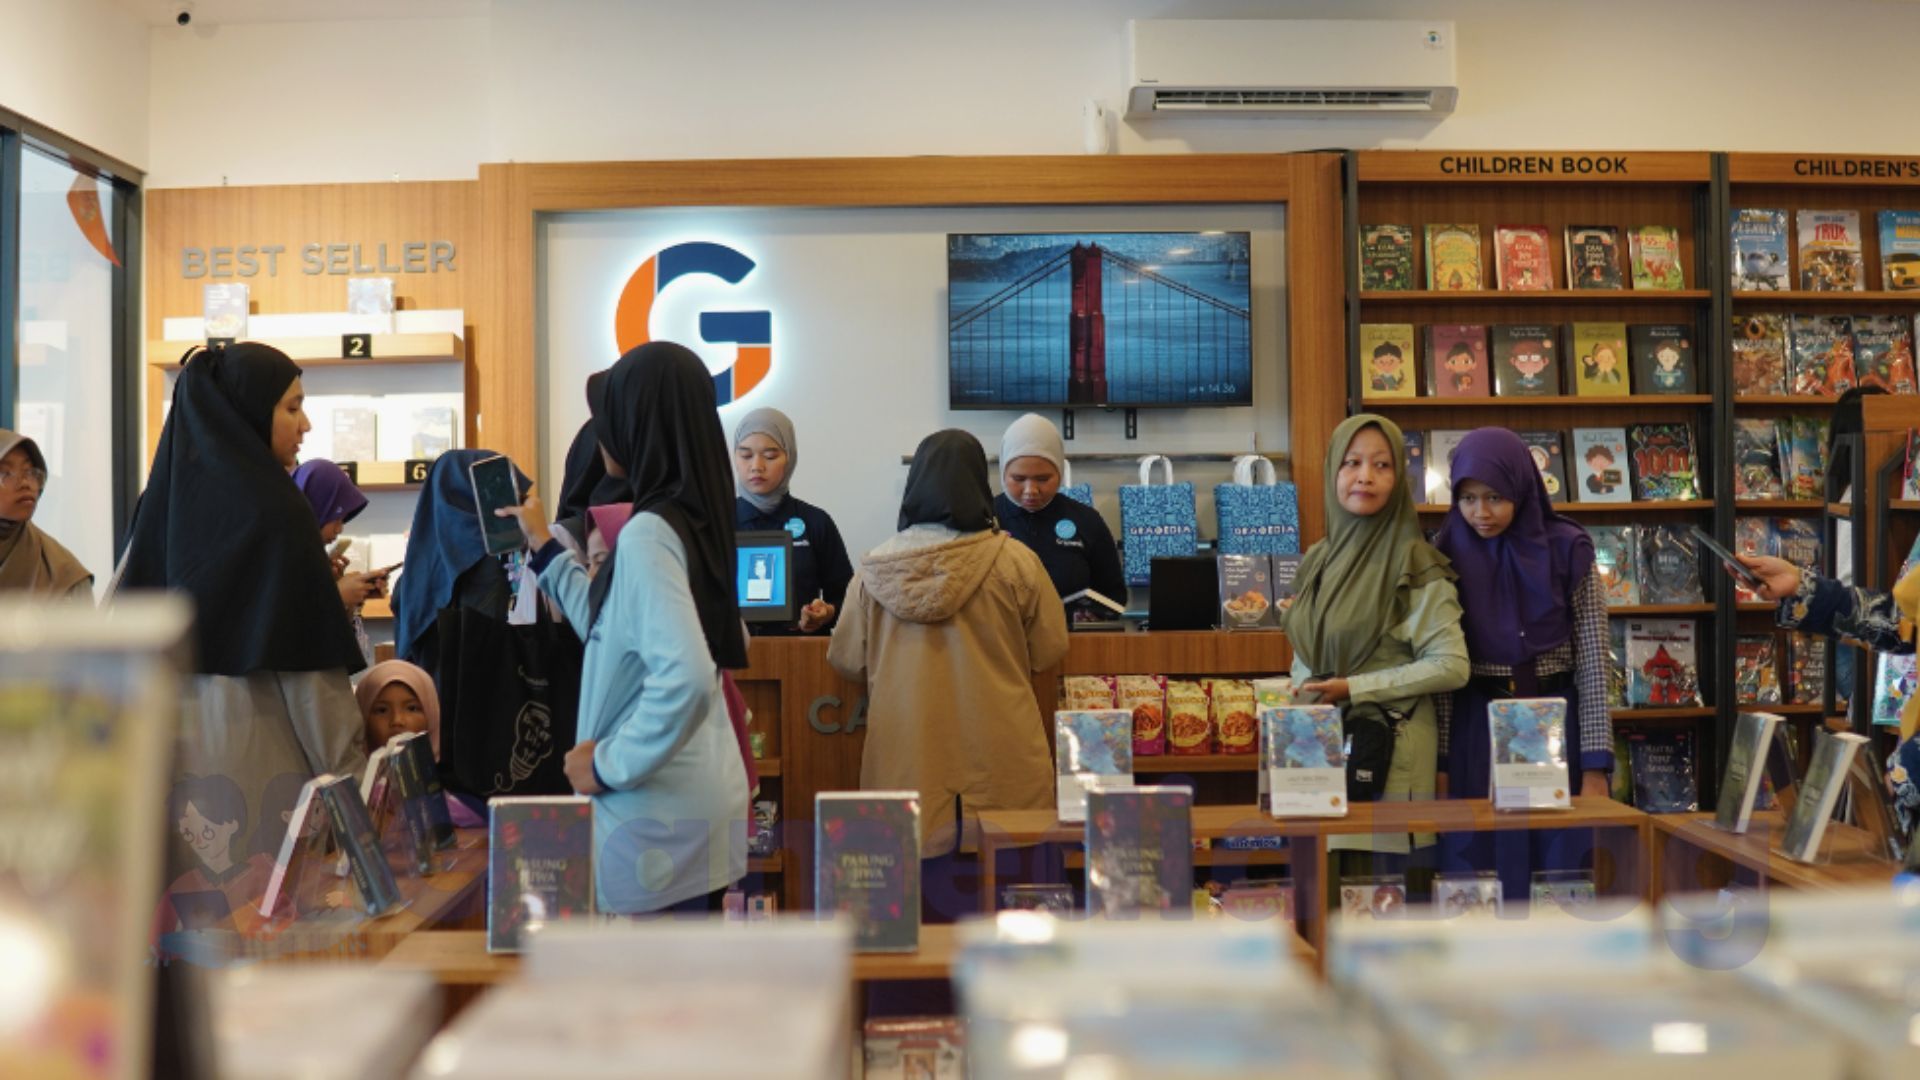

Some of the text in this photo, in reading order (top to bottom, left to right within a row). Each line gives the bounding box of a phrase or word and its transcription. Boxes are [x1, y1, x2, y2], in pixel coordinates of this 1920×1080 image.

[1440, 156, 1628, 174] CHILDREN BOOK
[1793, 159, 1920, 177] CHILDREN'S
[181, 240, 457, 279] BEST SELLER
[615, 241, 772, 407] G
[350, 337, 364, 356] 2
[412, 463, 427, 481] 6
